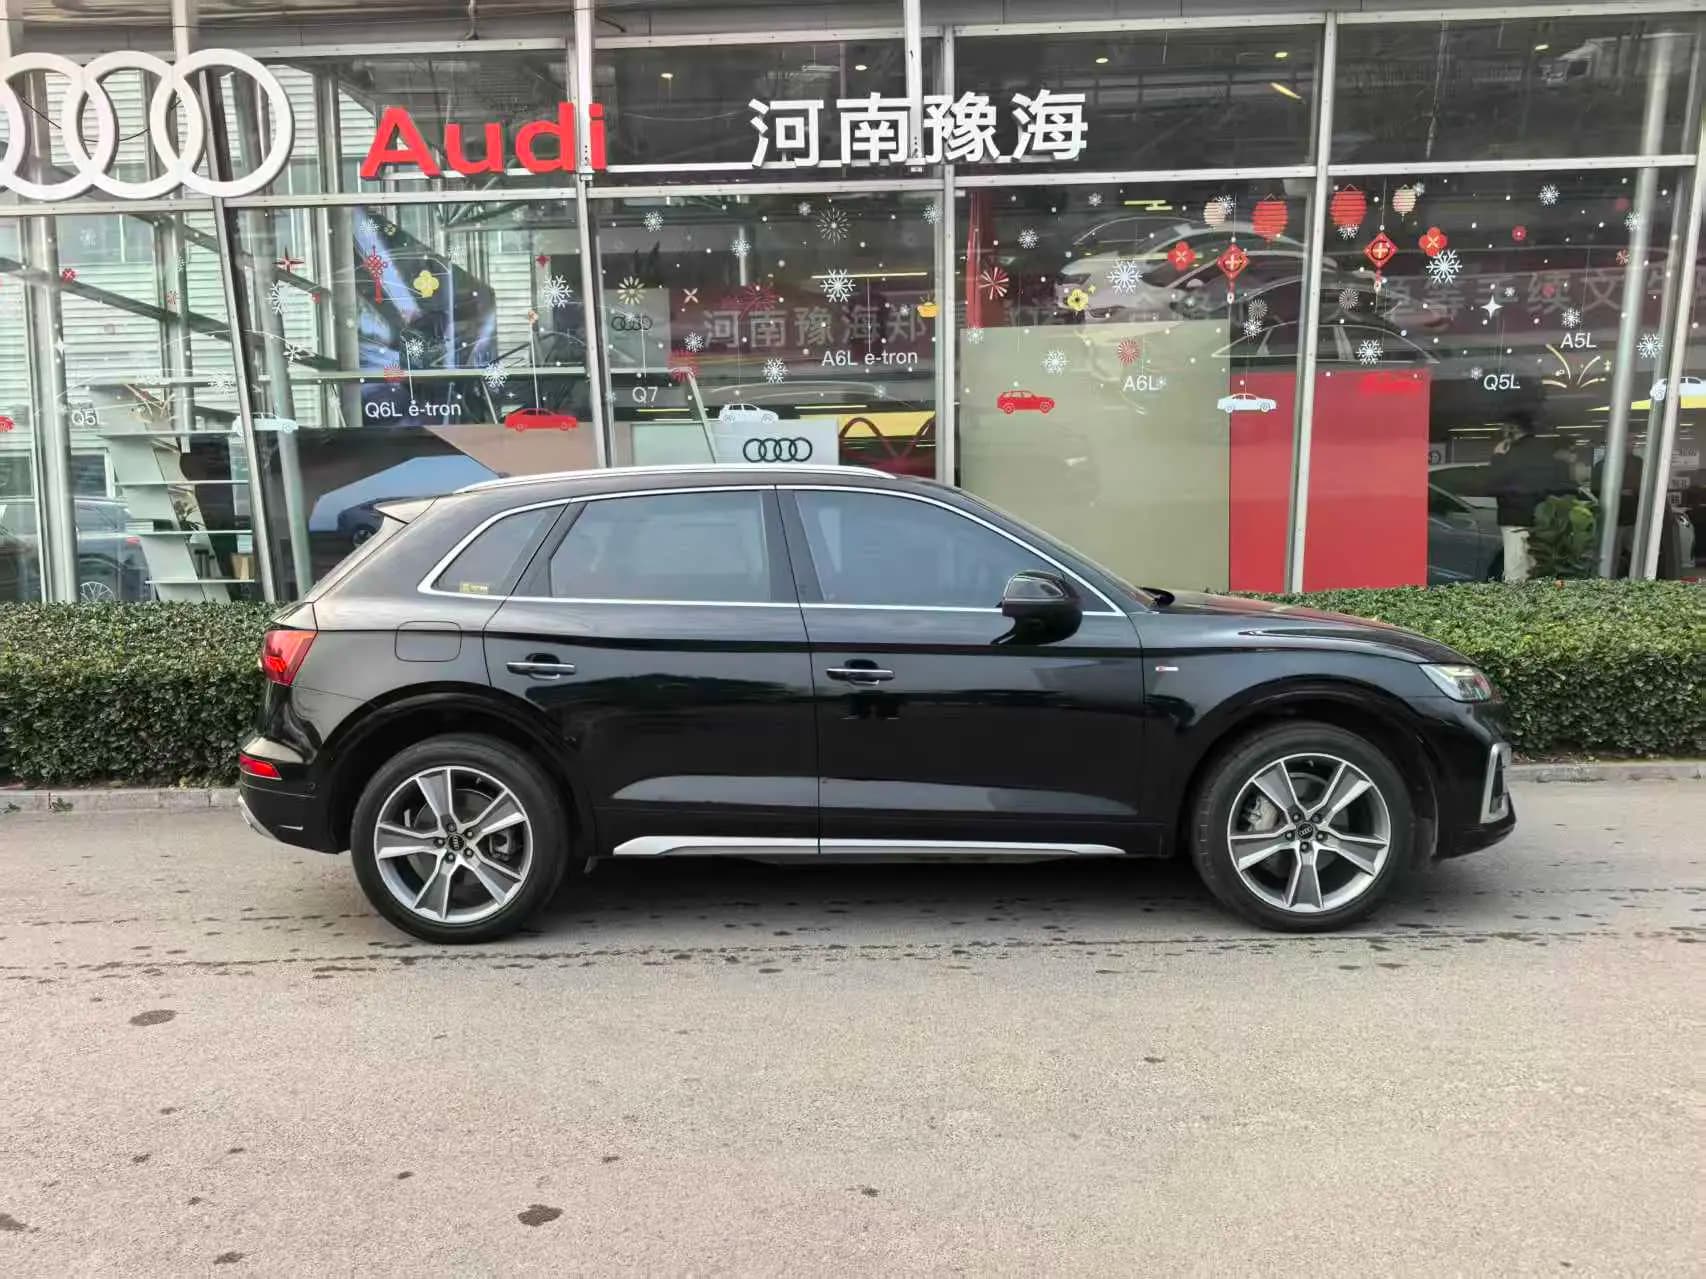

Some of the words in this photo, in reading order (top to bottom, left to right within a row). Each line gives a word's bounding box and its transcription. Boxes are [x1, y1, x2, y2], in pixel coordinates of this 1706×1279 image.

[748, 89, 1089, 167] 河南豫海
[360, 102, 607, 179] Audi
[1560, 332, 1597, 349] A5L
[821, 350, 858, 367] A6L
[864, 349, 918, 366] e-tron
[1122, 375, 1161, 392] A6L
[1483, 373, 1521, 391] Q5L
[632, 386, 658, 404] Q7
[365, 401, 403, 418] Q6L
[408, 402, 462, 417] e-tron
